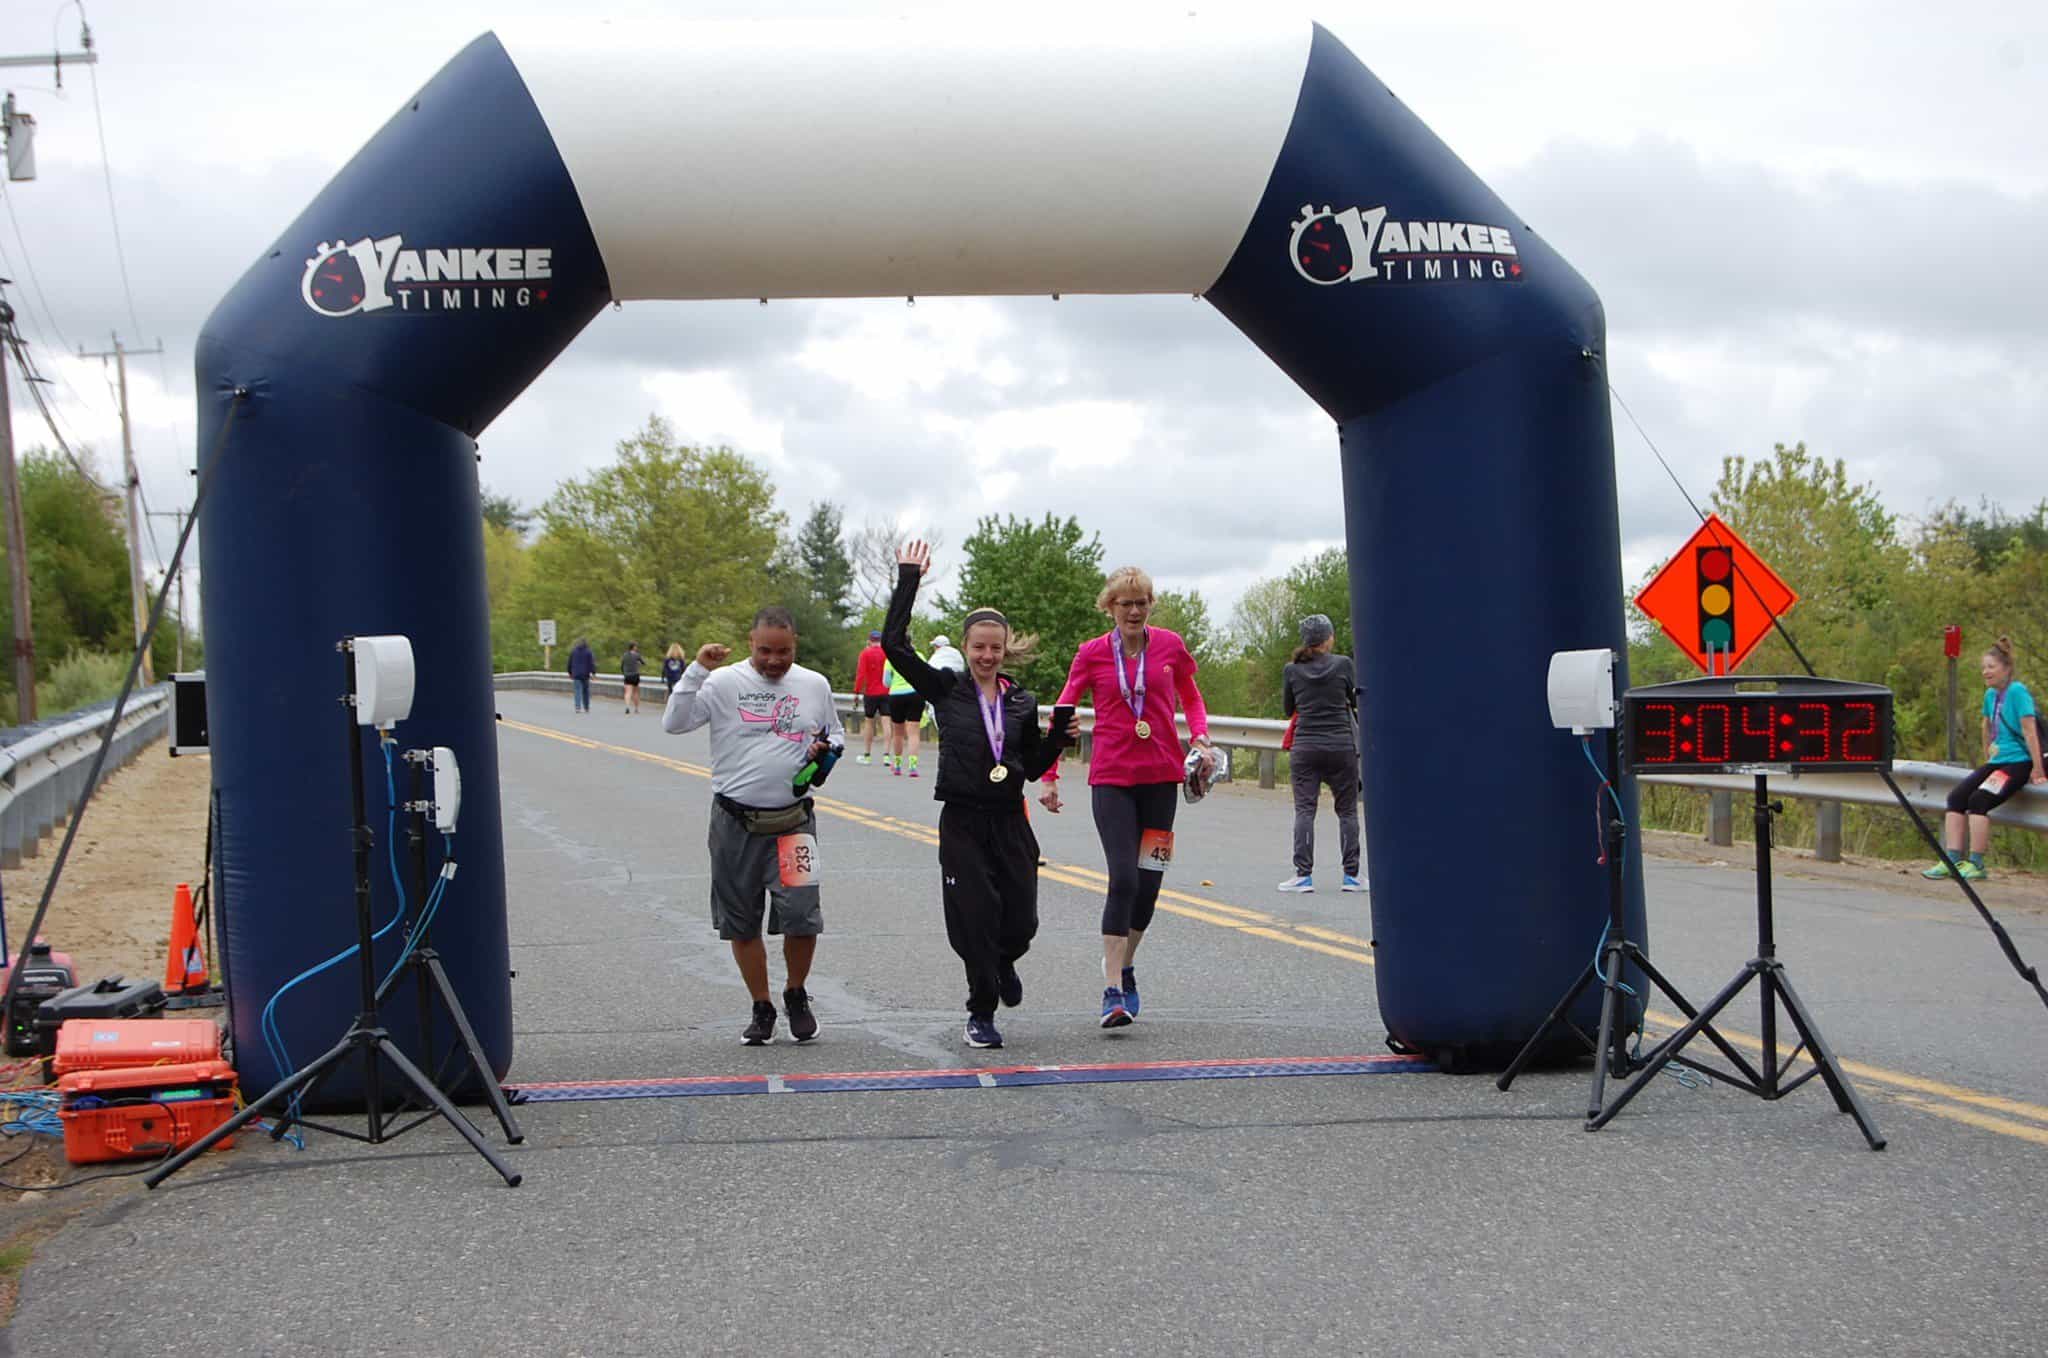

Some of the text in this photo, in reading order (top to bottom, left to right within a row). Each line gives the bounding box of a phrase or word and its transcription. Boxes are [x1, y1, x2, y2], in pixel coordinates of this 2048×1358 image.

[1335, 206, 1517, 282] YANKEE
[348, 235, 552, 312] YANKEE
[1383, 260, 1505, 281] TIMING
[397, 287, 531, 310] TIMING
[1644, 703, 1876, 763] 3:04:32
[794, 845, 812, 873] 233
